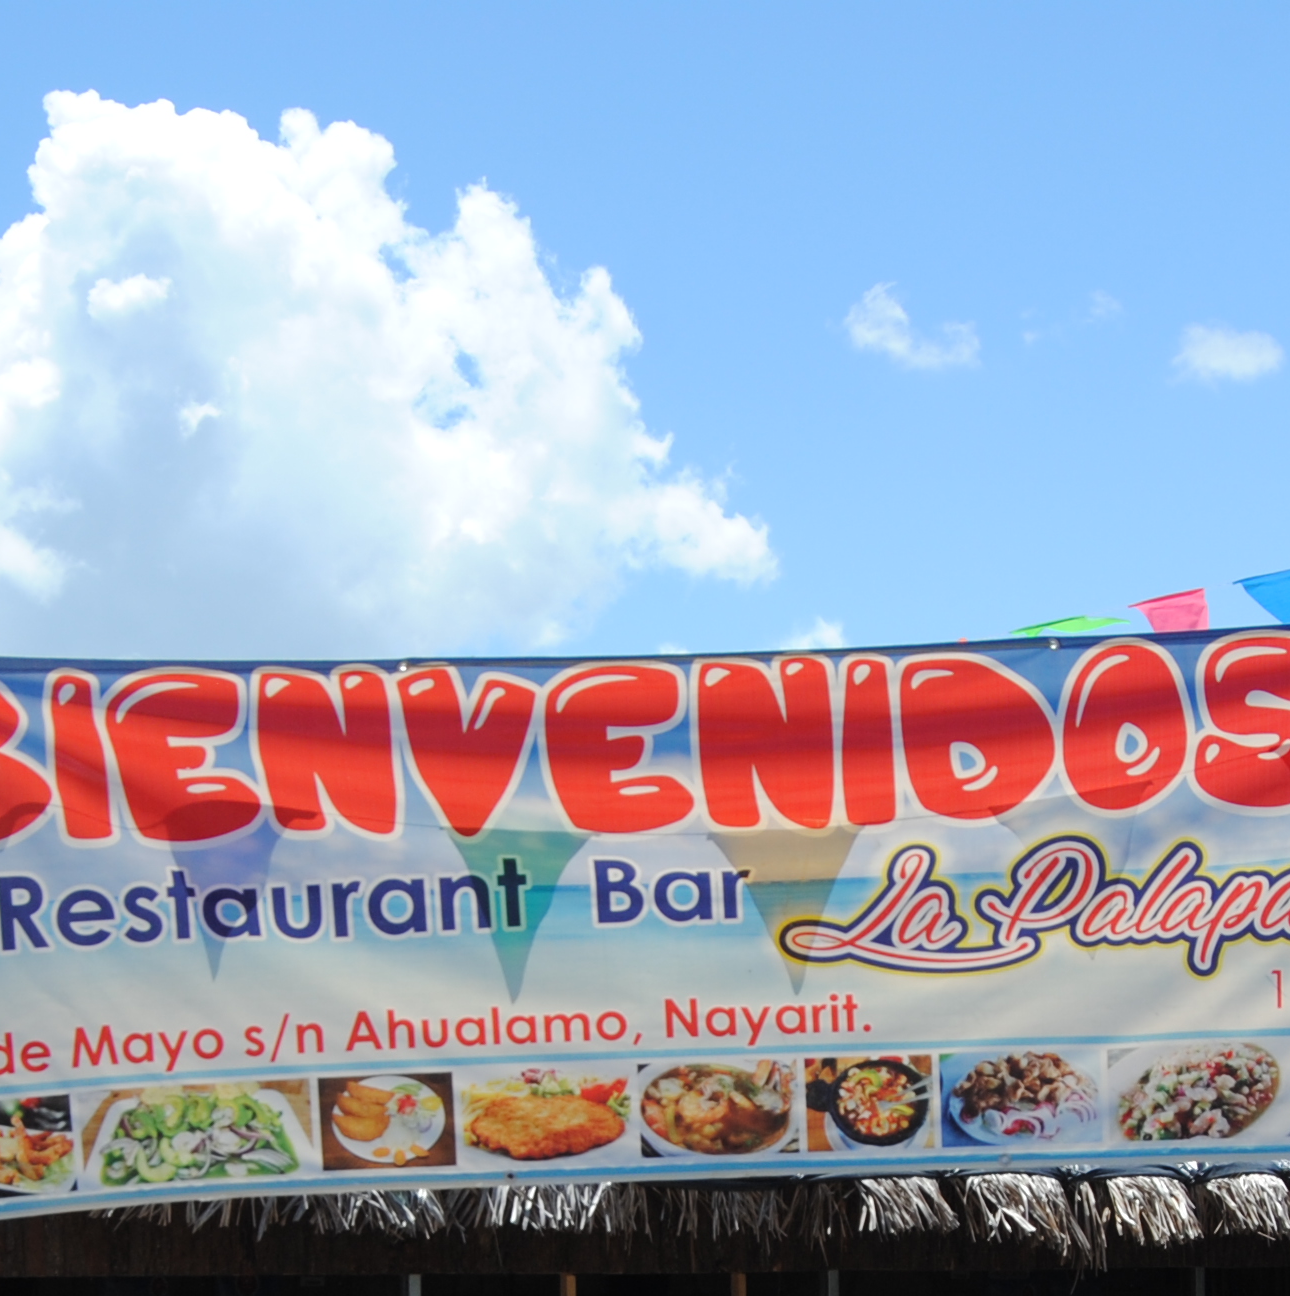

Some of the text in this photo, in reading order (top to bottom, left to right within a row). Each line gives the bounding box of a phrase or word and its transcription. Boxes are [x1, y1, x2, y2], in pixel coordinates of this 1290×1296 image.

[594, 857, 746, 926] Bar
[780, 845, 1041, 974] La
[72, 1022, 225, 1080] Mayo
[244, 1012, 325, 1061] s/n
[346, 1006, 643, 1054] Ahualamo,
[664, 993, 872, 1047] Nayarit.
